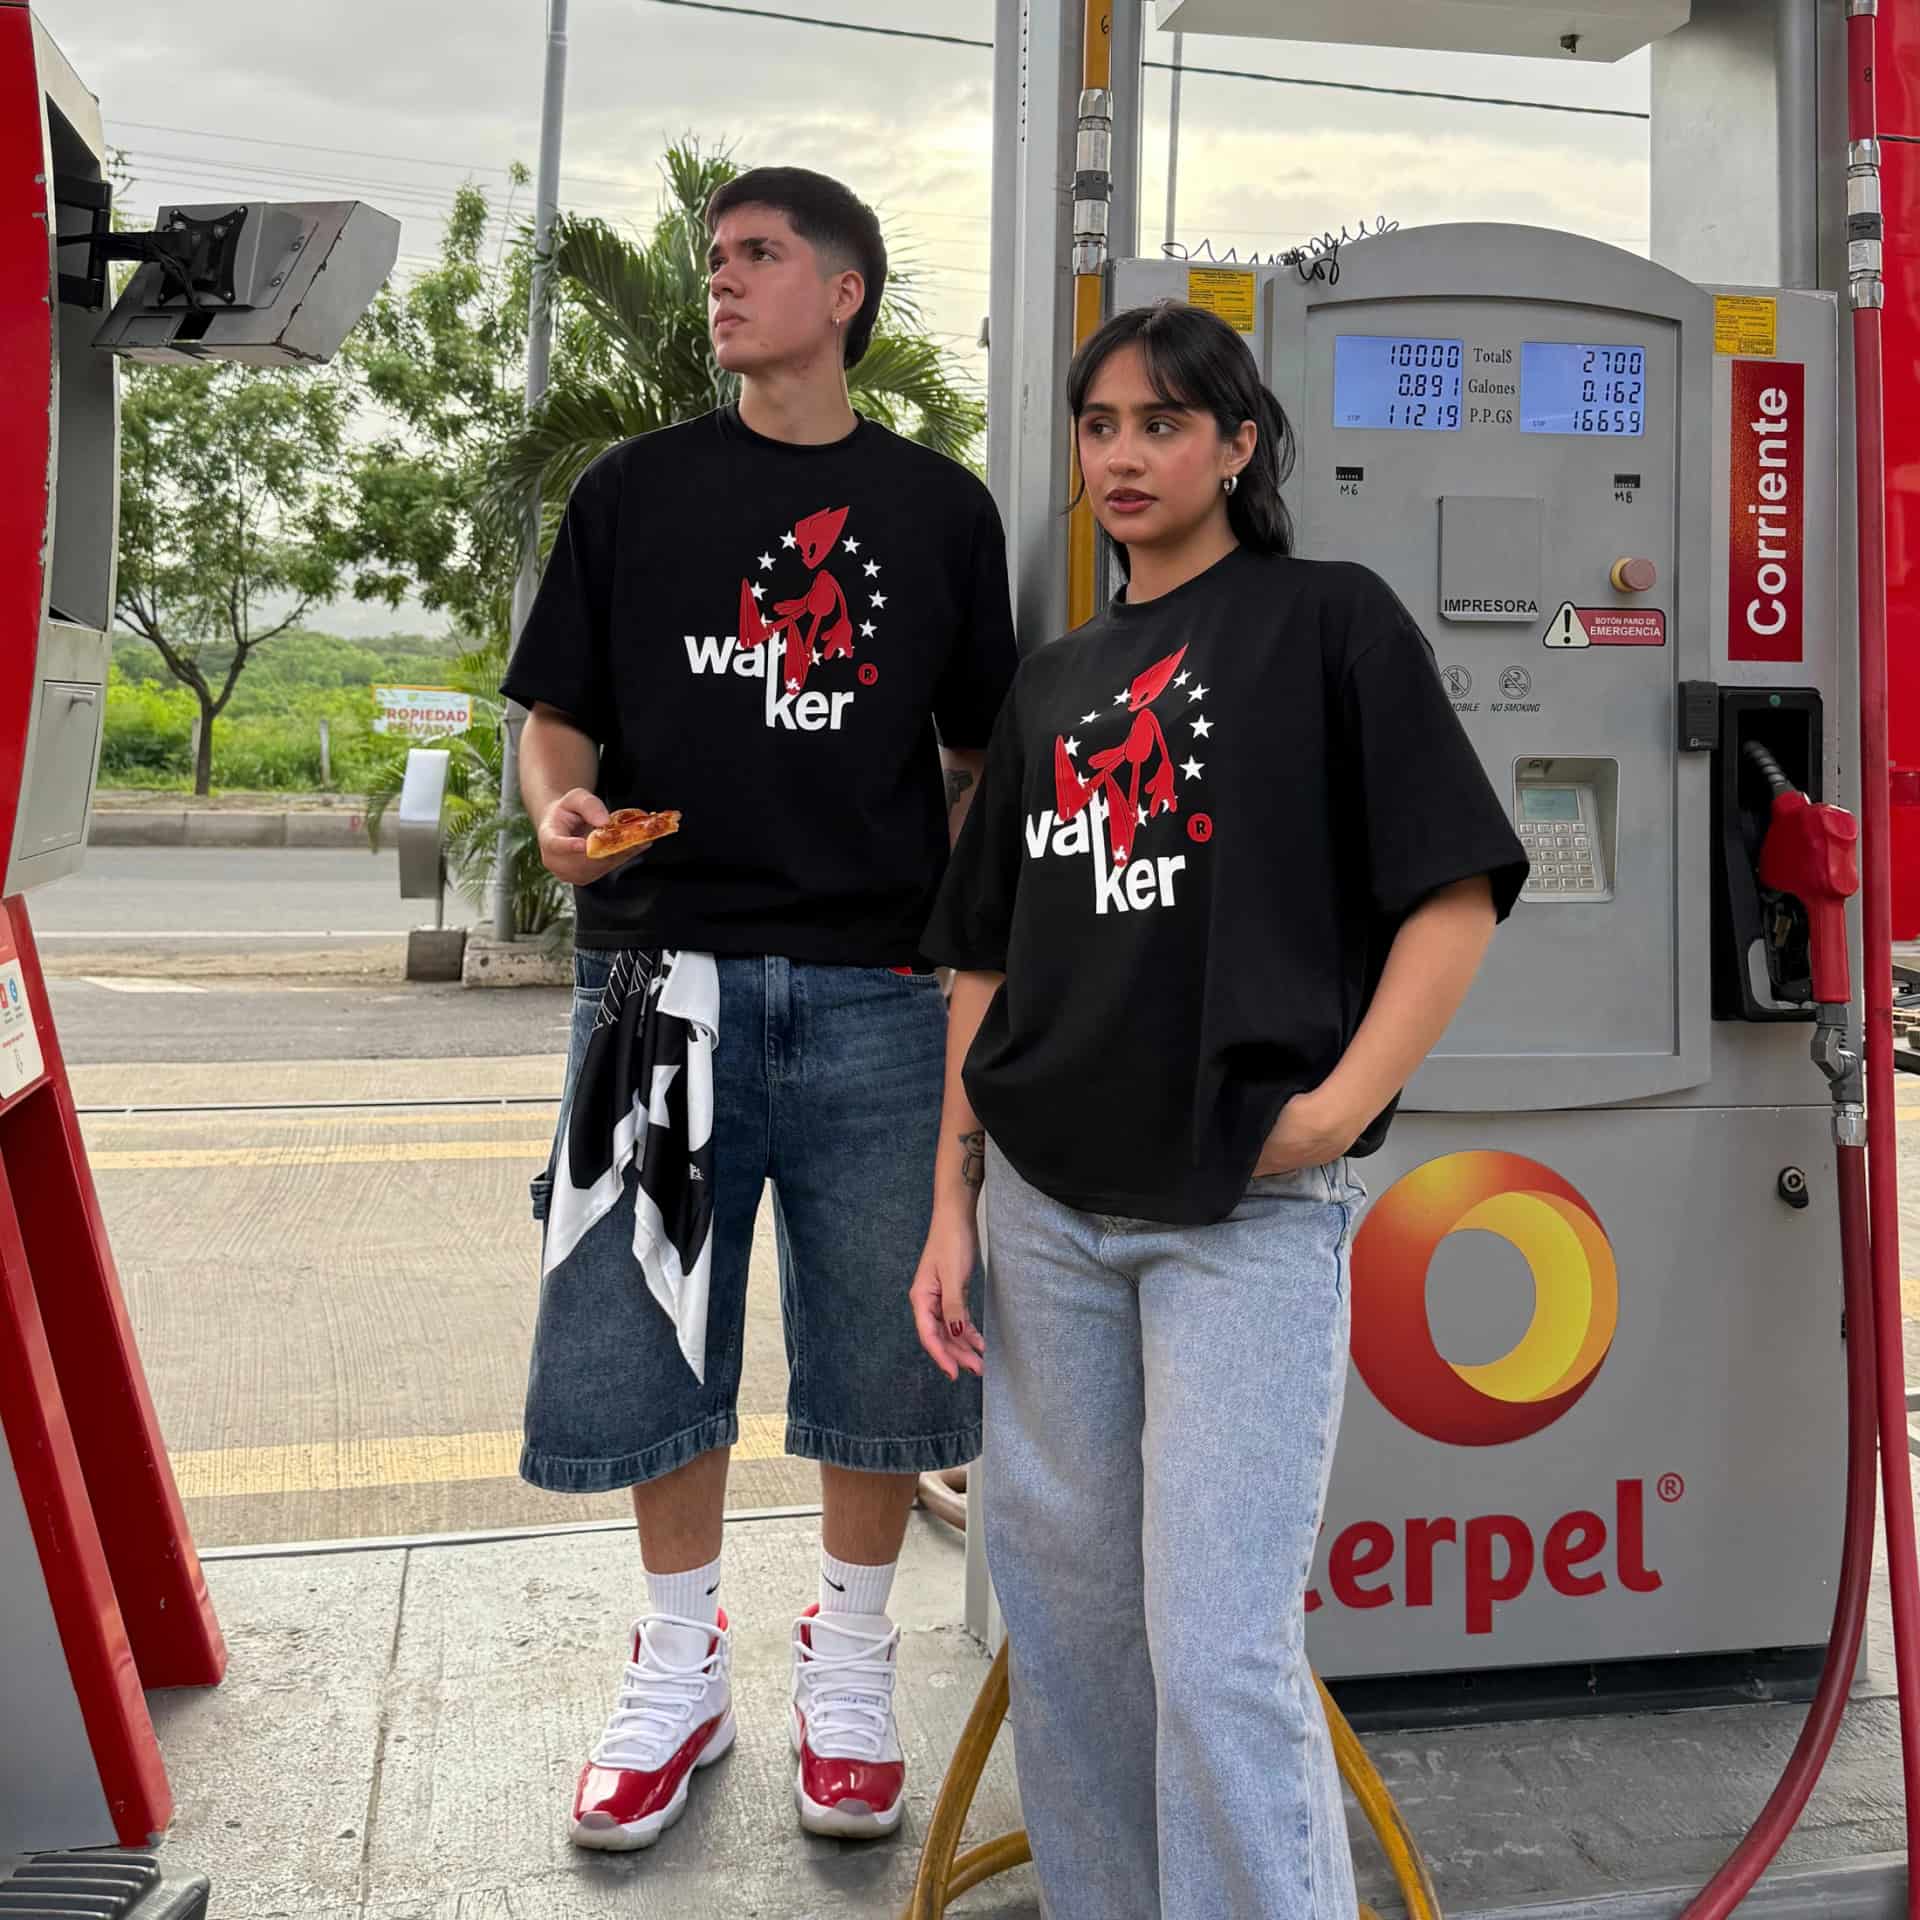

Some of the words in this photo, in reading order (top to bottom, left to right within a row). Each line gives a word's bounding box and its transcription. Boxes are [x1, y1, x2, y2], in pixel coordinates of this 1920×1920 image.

[1391, 344, 1459, 368] 10000
[1583, 351, 1641, 375] 2700
[1398, 373, 1459, 397] 0.891
[1467, 378, 1516, 395] Galones
[1582, 380, 1641, 404] 0.162
[1389, 403, 1458, 427] 11219
[1573, 409, 1640, 433] 16659
[1340, 483, 1359, 496] M6
[1746, 387, 1788, 635] Corriente
[1444, 599, 1538, 613] IMPRESORA
[1590, 626, 1661, 637] EMERGENCIA
[386, 708, 468, 722] ROPIEDAD
[1490, 703, 1503, 713] NO
[1503, 703, 1541, 713] SMOKING
[1305, 1479, 1664, 1635] erpel
